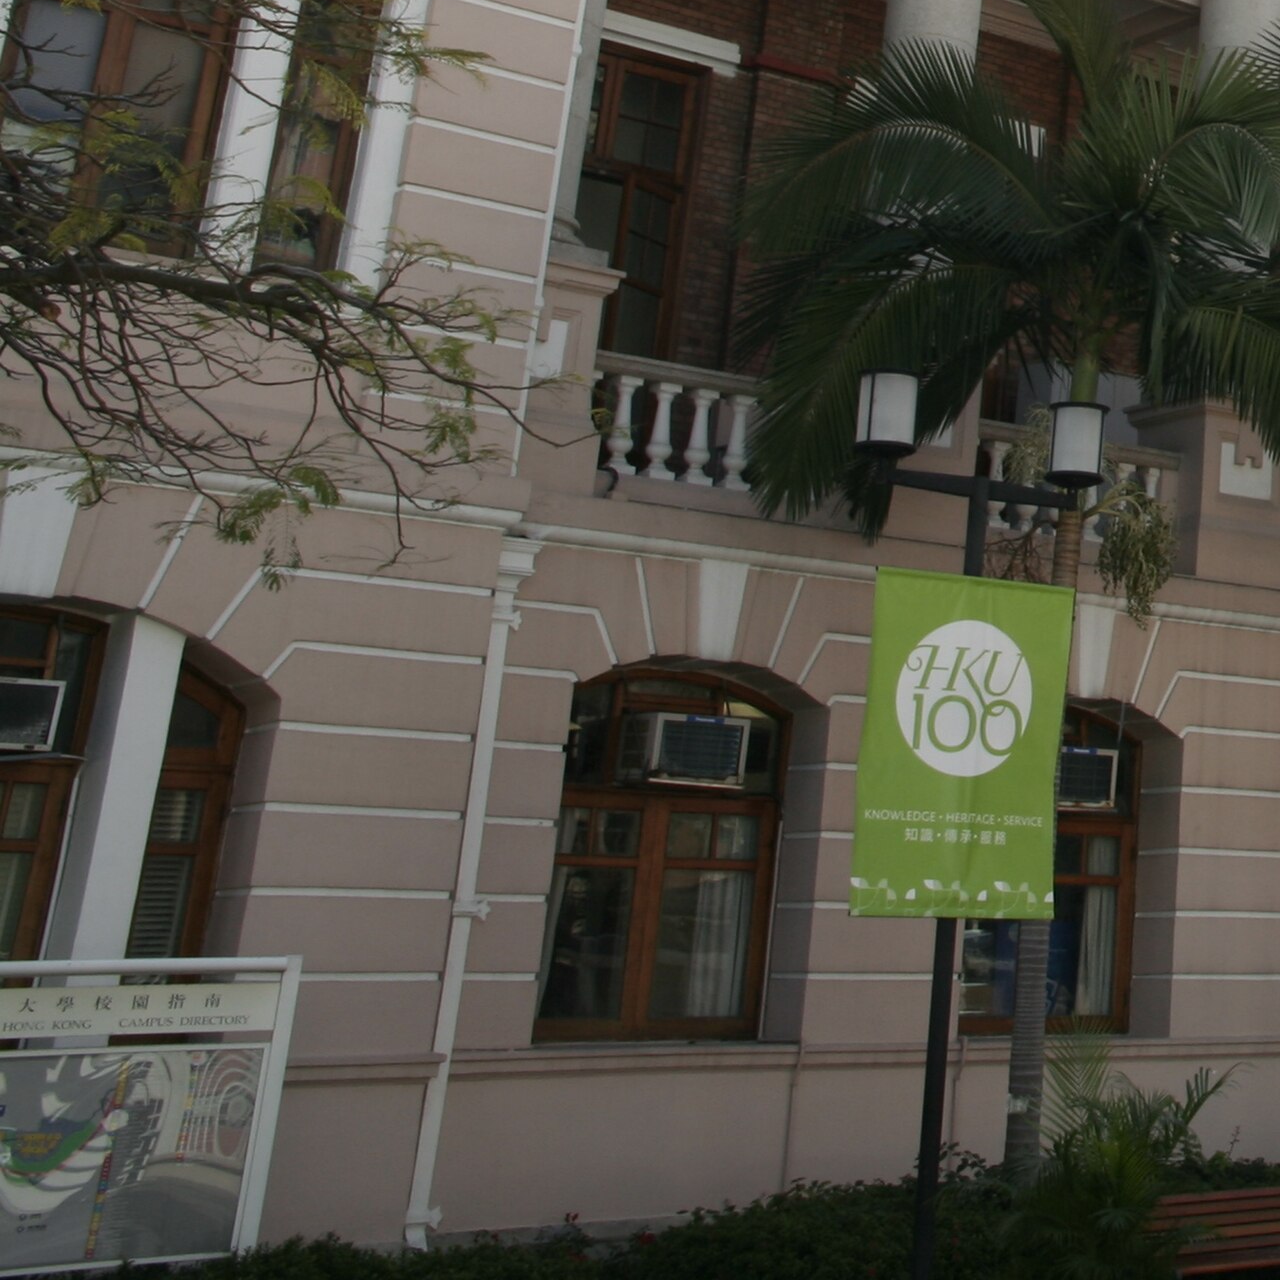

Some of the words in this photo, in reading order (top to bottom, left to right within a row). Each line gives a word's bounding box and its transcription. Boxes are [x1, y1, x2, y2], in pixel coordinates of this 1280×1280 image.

[906, 643, 1024, 701] HKU
[912, 693, 1024, 757] 100
[864, 808, 936, 823] KNOWLEDGE
[946, 812, 995, 825] HERITAGE
[1003, 814, 1043, 827] SERVICE
[19, 992, 222, 1014] 大學校園指南
[3, 1020, 45, 1032] HONG
[52, 1019, 92, 1030] KONG
[119, 1016, 174, 1028] CAMPUS
[179, 1014, 251, 1027] DIRECTORY
